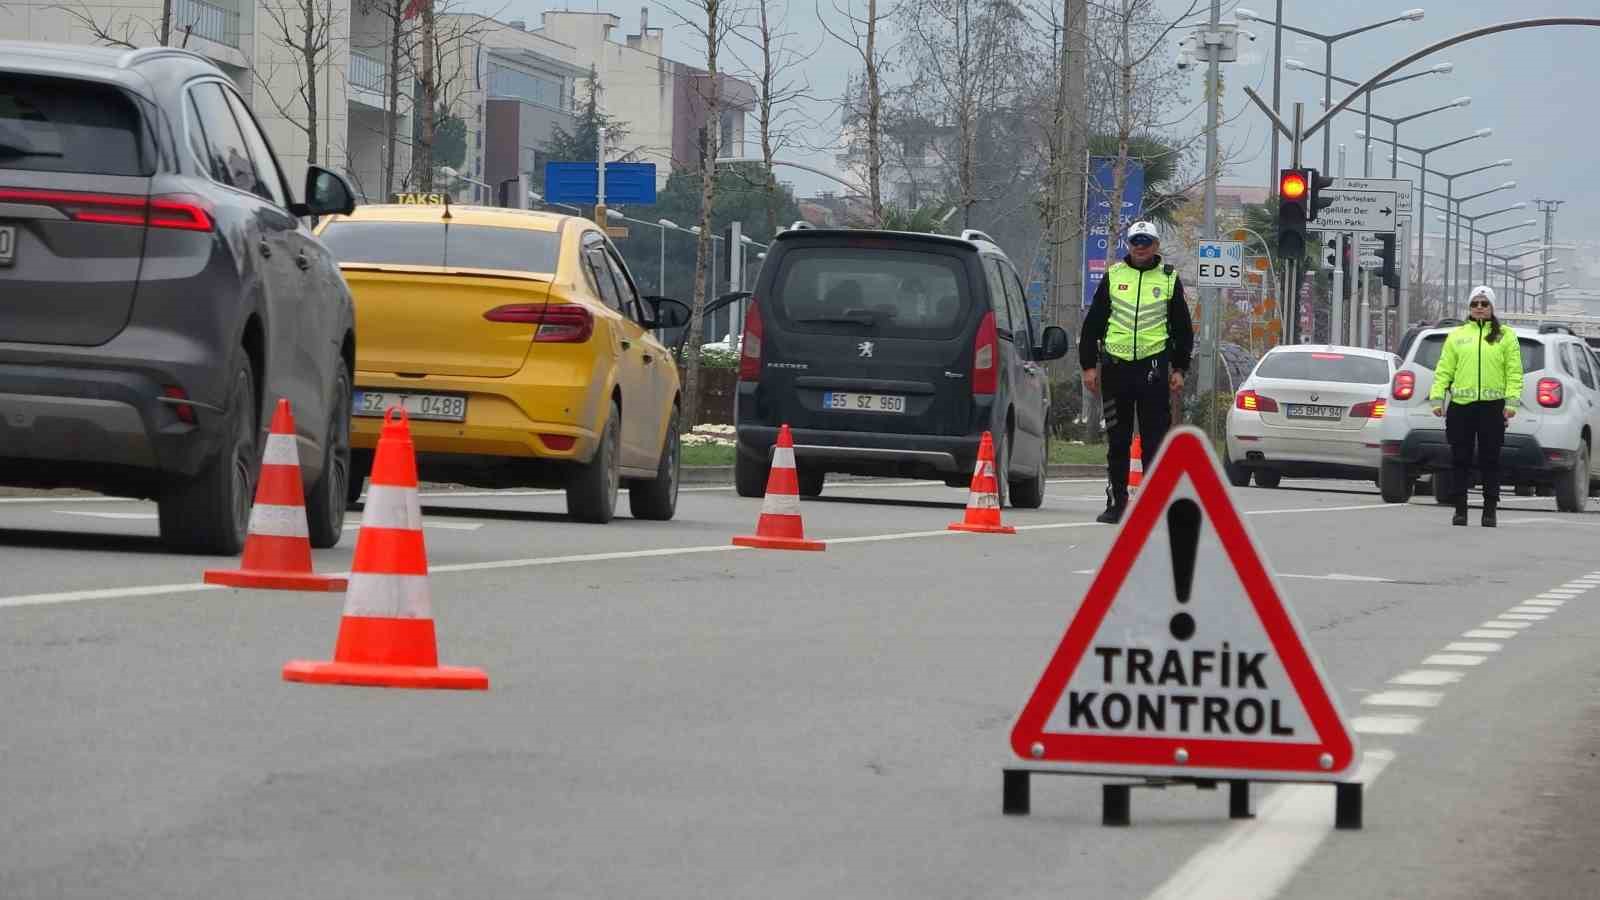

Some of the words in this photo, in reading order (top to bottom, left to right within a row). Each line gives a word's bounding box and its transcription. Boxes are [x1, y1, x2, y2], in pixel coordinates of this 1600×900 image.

[364, 394, 383, 410] 52
[399, 395, 409, 409] T
[421, 396, 463, 416] 0488
[831, 393, 847, 408] 55
[857, 394, 873, 409] SZ
[879, 396, 901, 411] 960
[1095, 641, 1269, 690] TRAFİK
[1068, 691, 1295, 737] KONTROL
